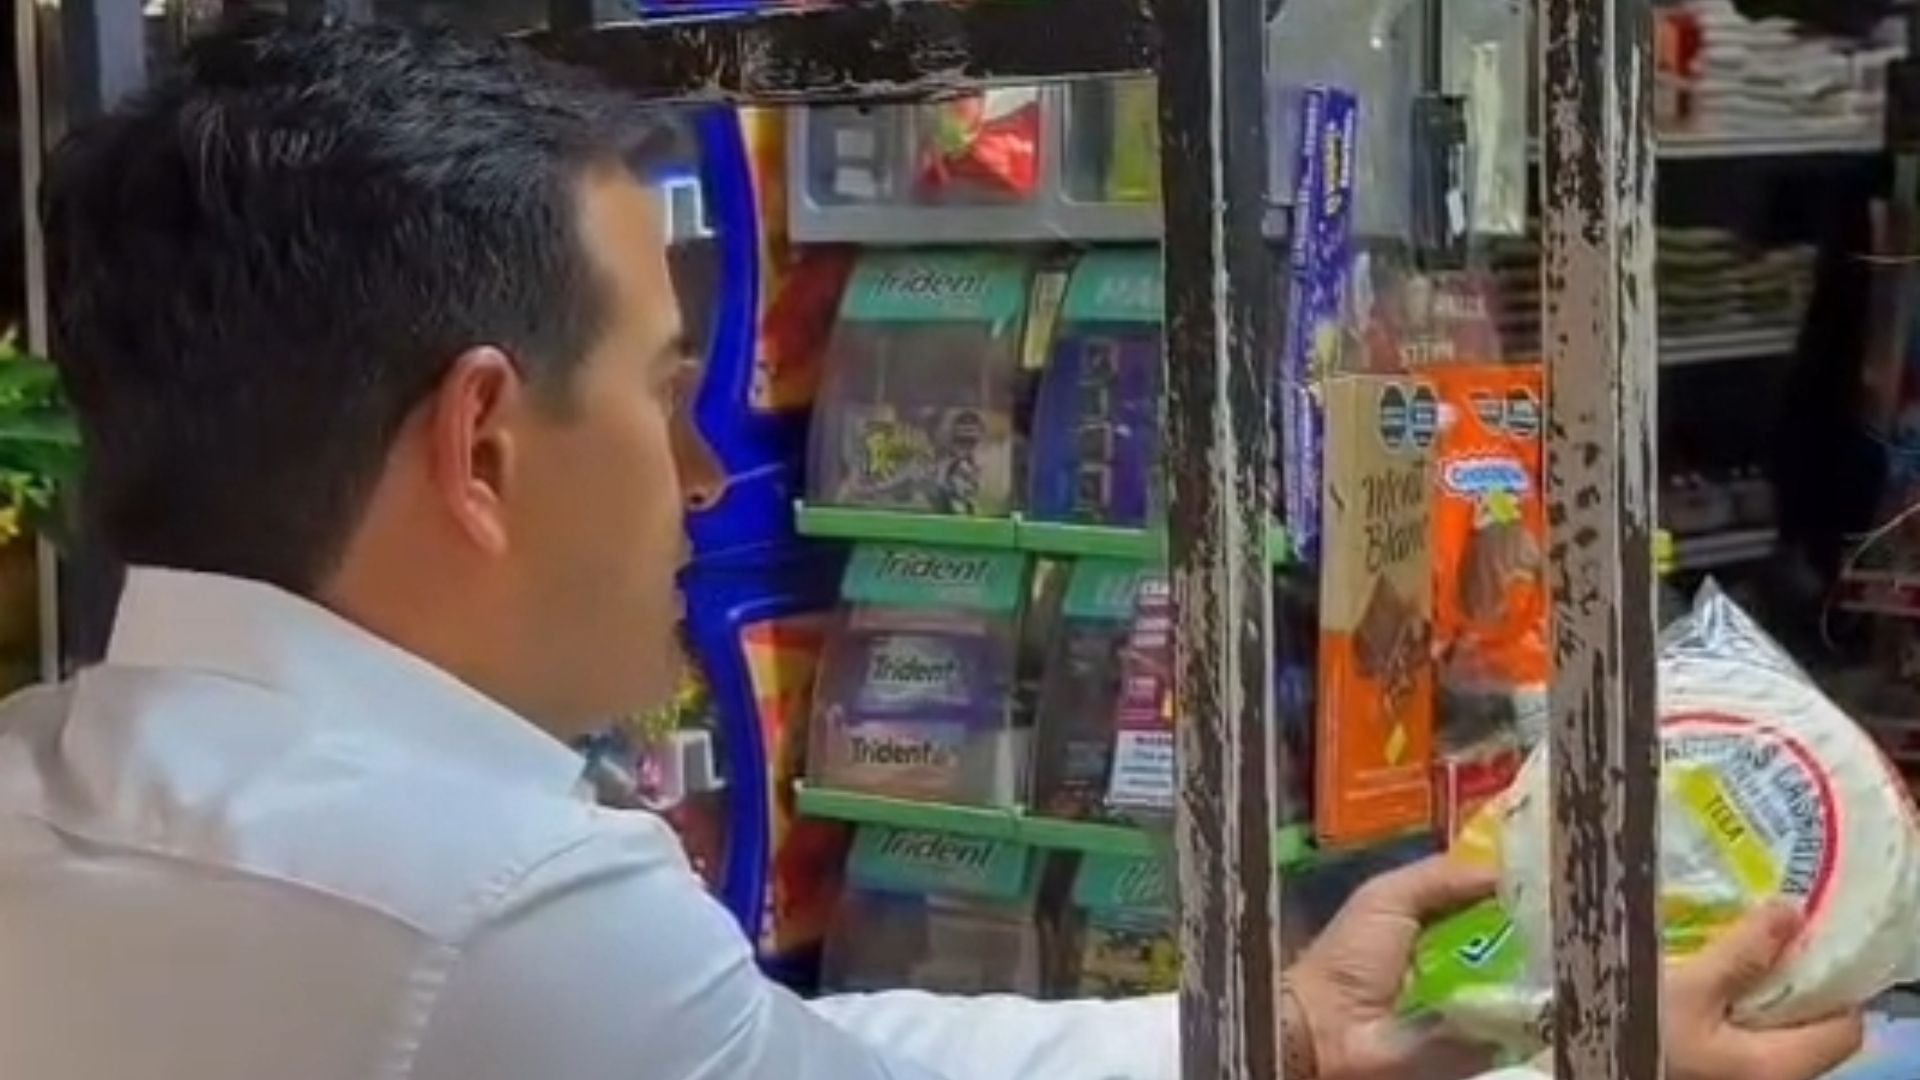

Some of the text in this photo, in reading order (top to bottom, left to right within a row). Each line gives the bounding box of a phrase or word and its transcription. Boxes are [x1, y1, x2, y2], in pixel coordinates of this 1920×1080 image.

[876, 550, 990, 583] Trident
[873, 655, 956, 683] Trident
[850, 737, 932, 765] Trident
[1704, 794, 1746, 842] TELA
[880, 828, 993, 867] Trident
